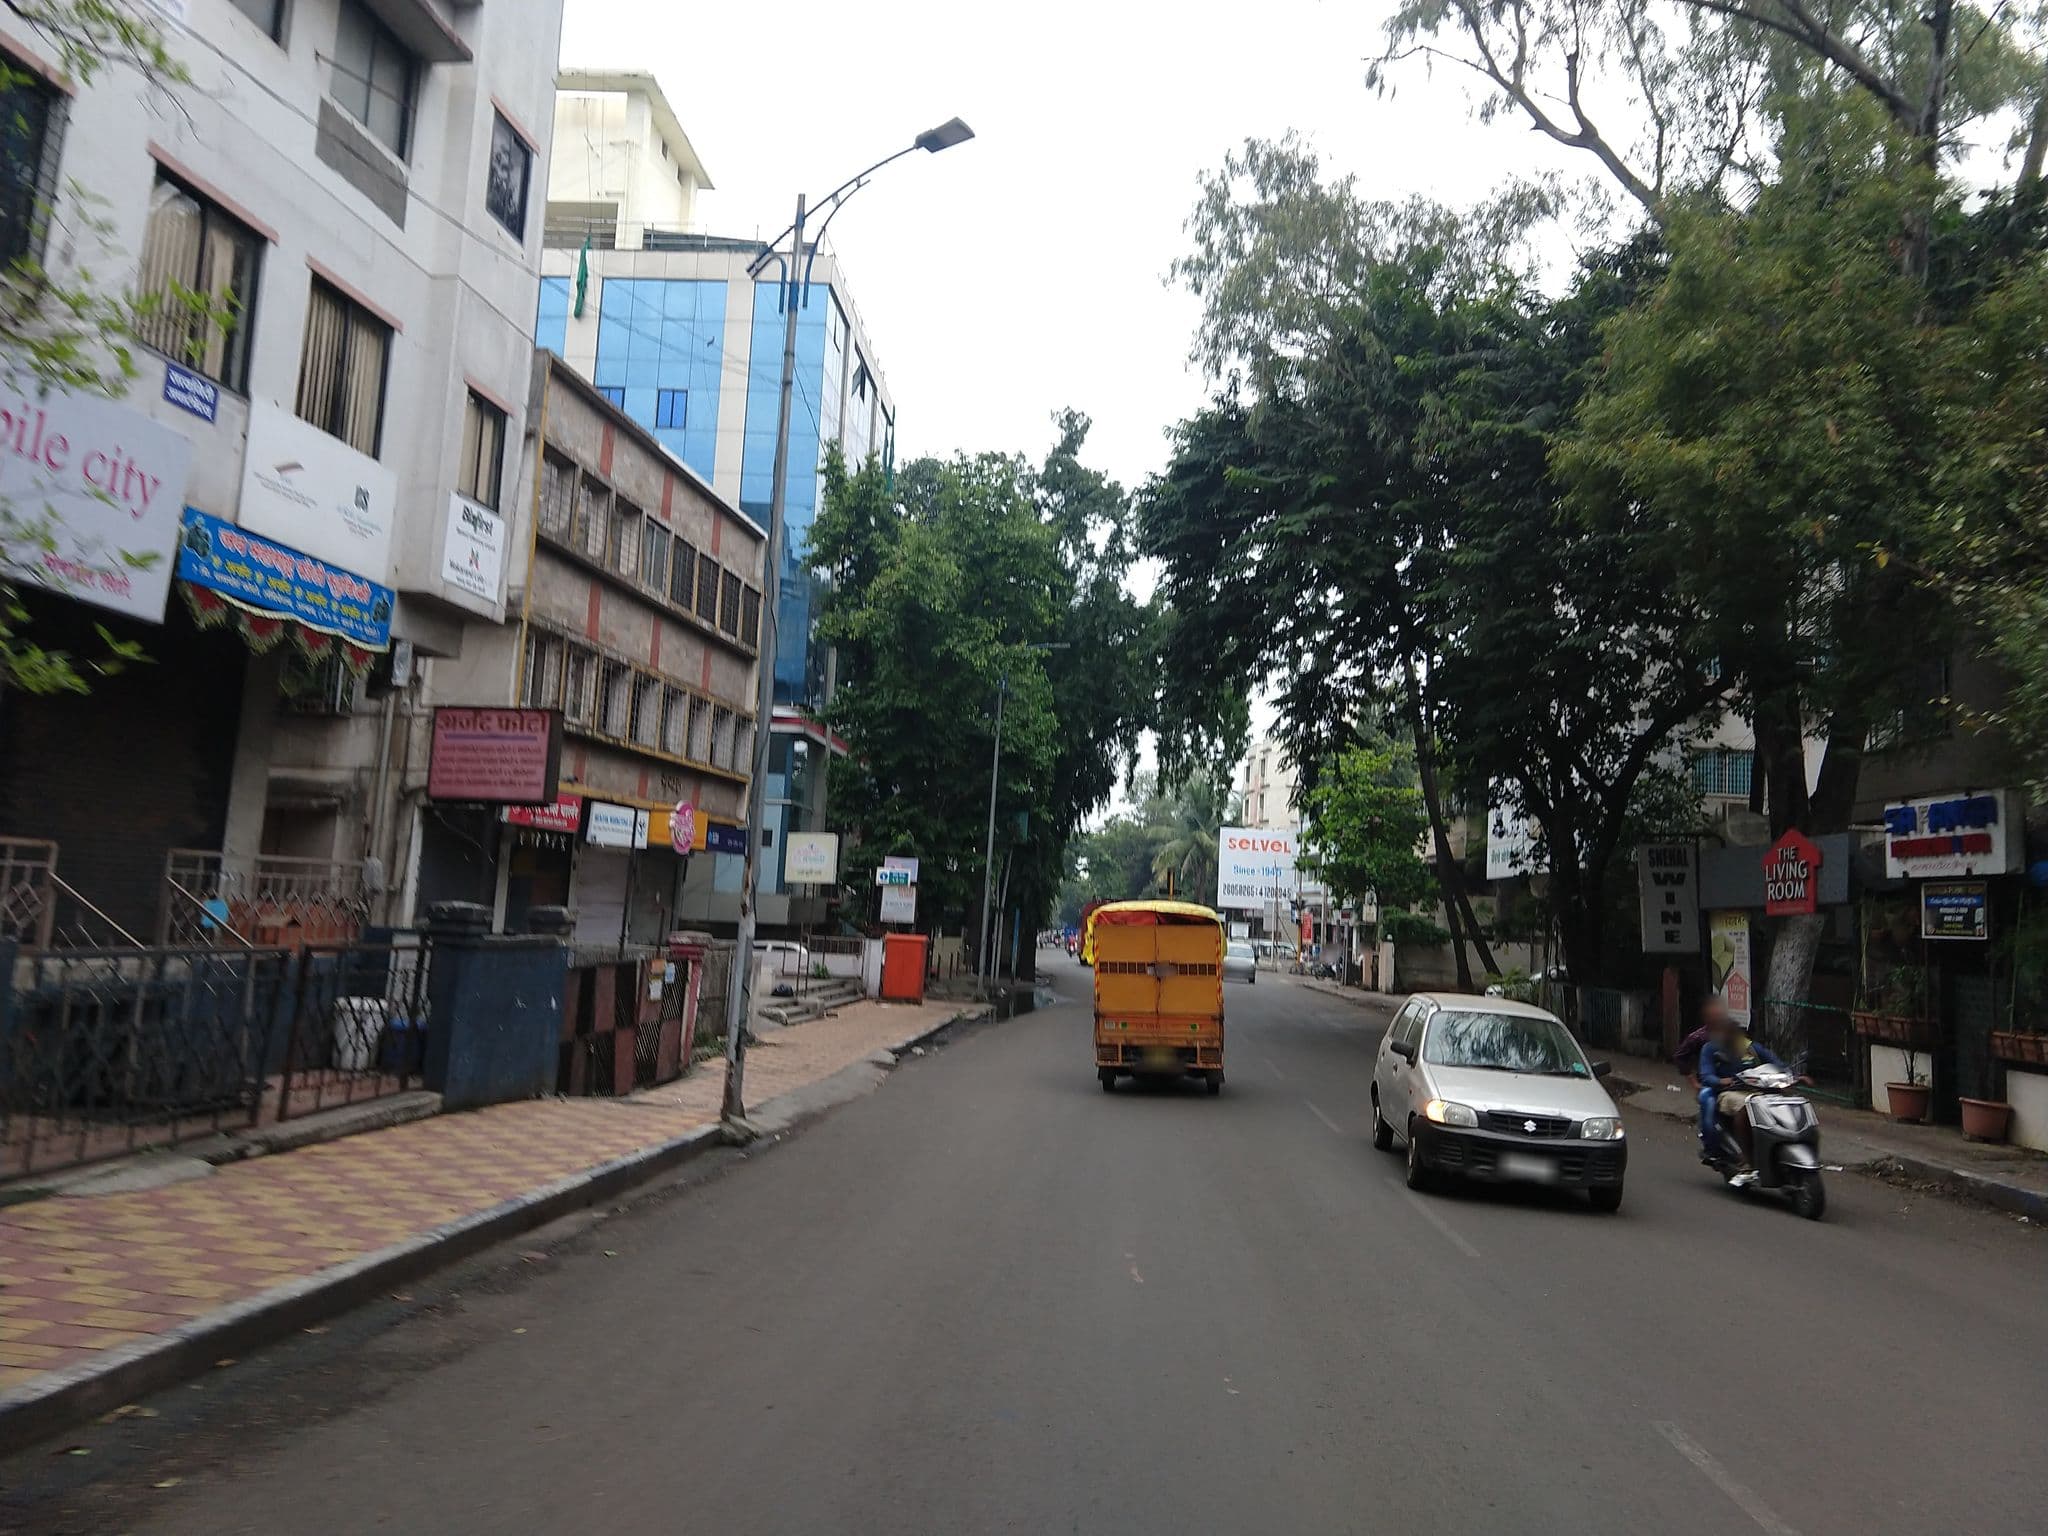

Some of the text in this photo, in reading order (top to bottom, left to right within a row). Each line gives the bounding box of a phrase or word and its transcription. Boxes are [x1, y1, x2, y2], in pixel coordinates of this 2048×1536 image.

[82, 445, 162, 520] city
[1777, 847, 1797, 860] THE
[1764, 859, 1808, 882] LIVING
[1766, 881, 1806, 901] ROOM
